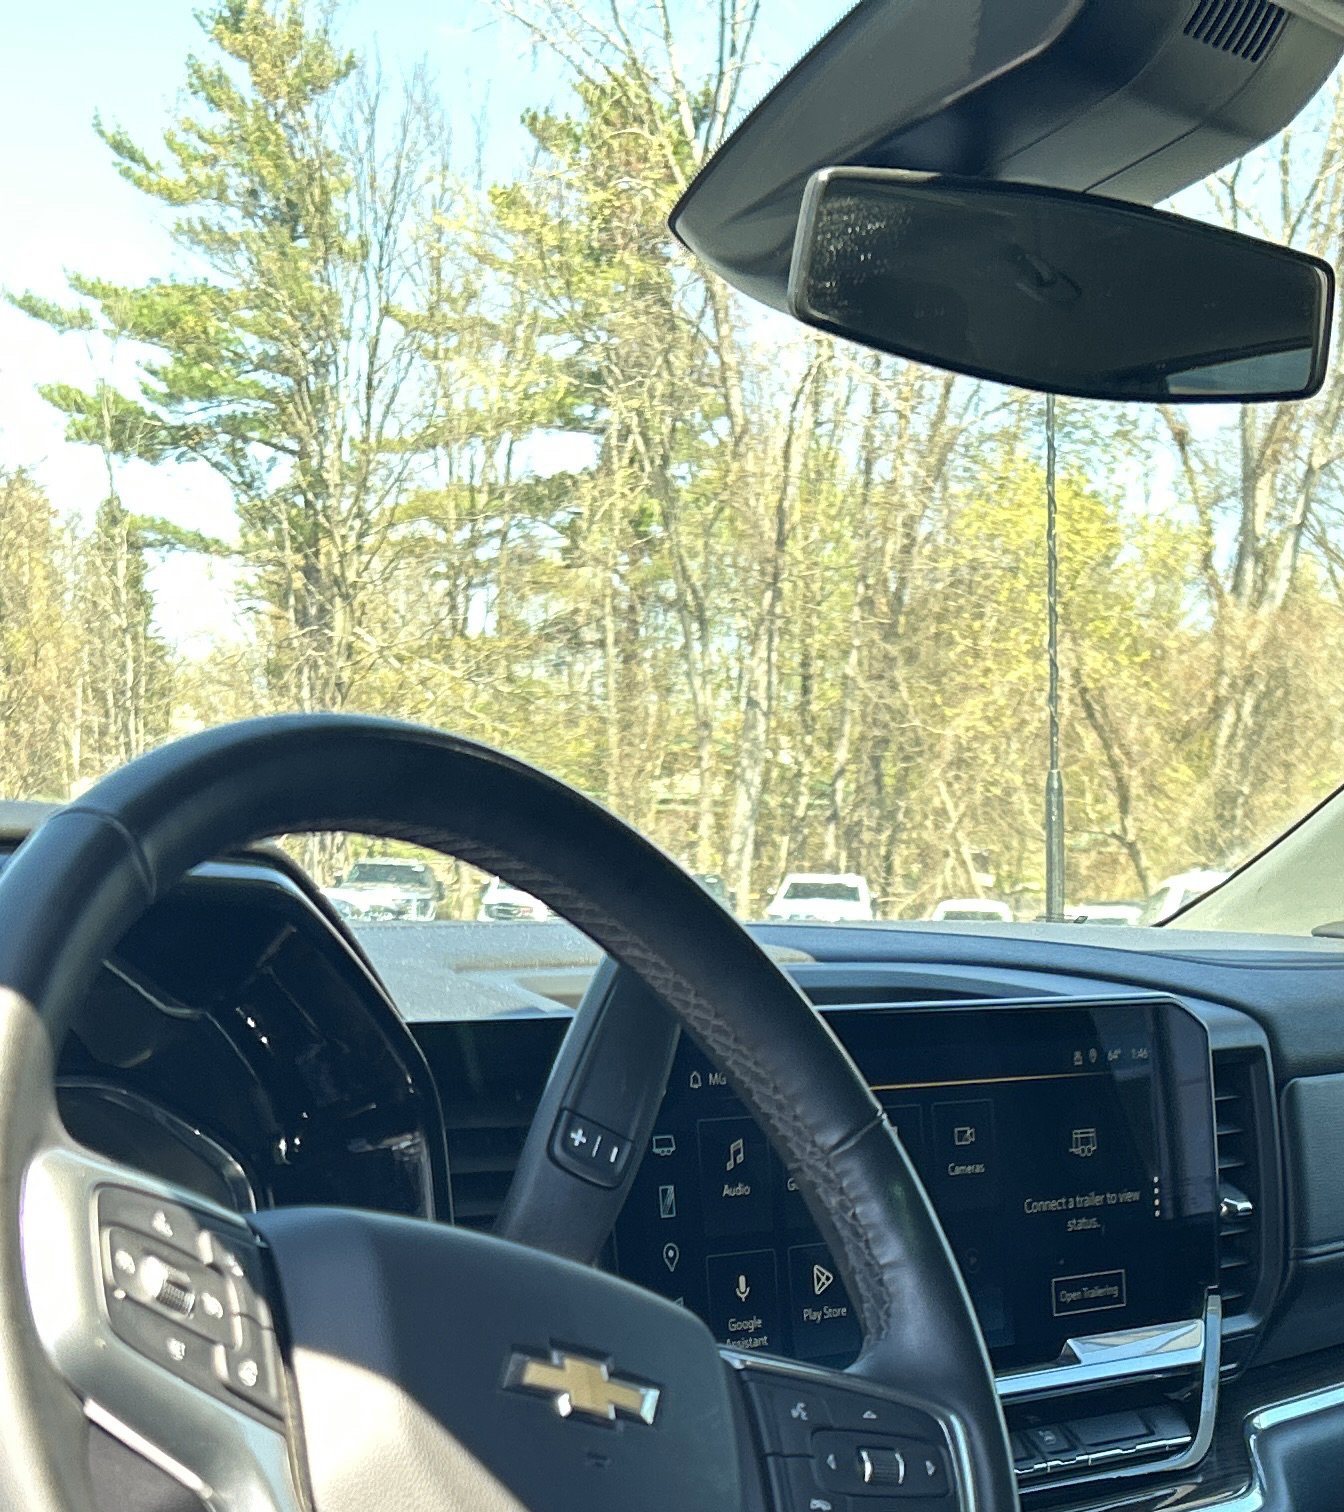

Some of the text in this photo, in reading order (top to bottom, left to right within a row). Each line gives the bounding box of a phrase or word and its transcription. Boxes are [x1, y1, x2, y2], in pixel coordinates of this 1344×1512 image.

[948, 1163, 985, 1176] Cameras
[722, 1182, 751, 1197] Audio
[1024, 1188, 1141, 1214] Connect a trailer to view
[1059, 1290, 1082, 1304] Open
[803, 1305, 847, 1323] Play Store
[728, 1315, 763, 1333] Google
